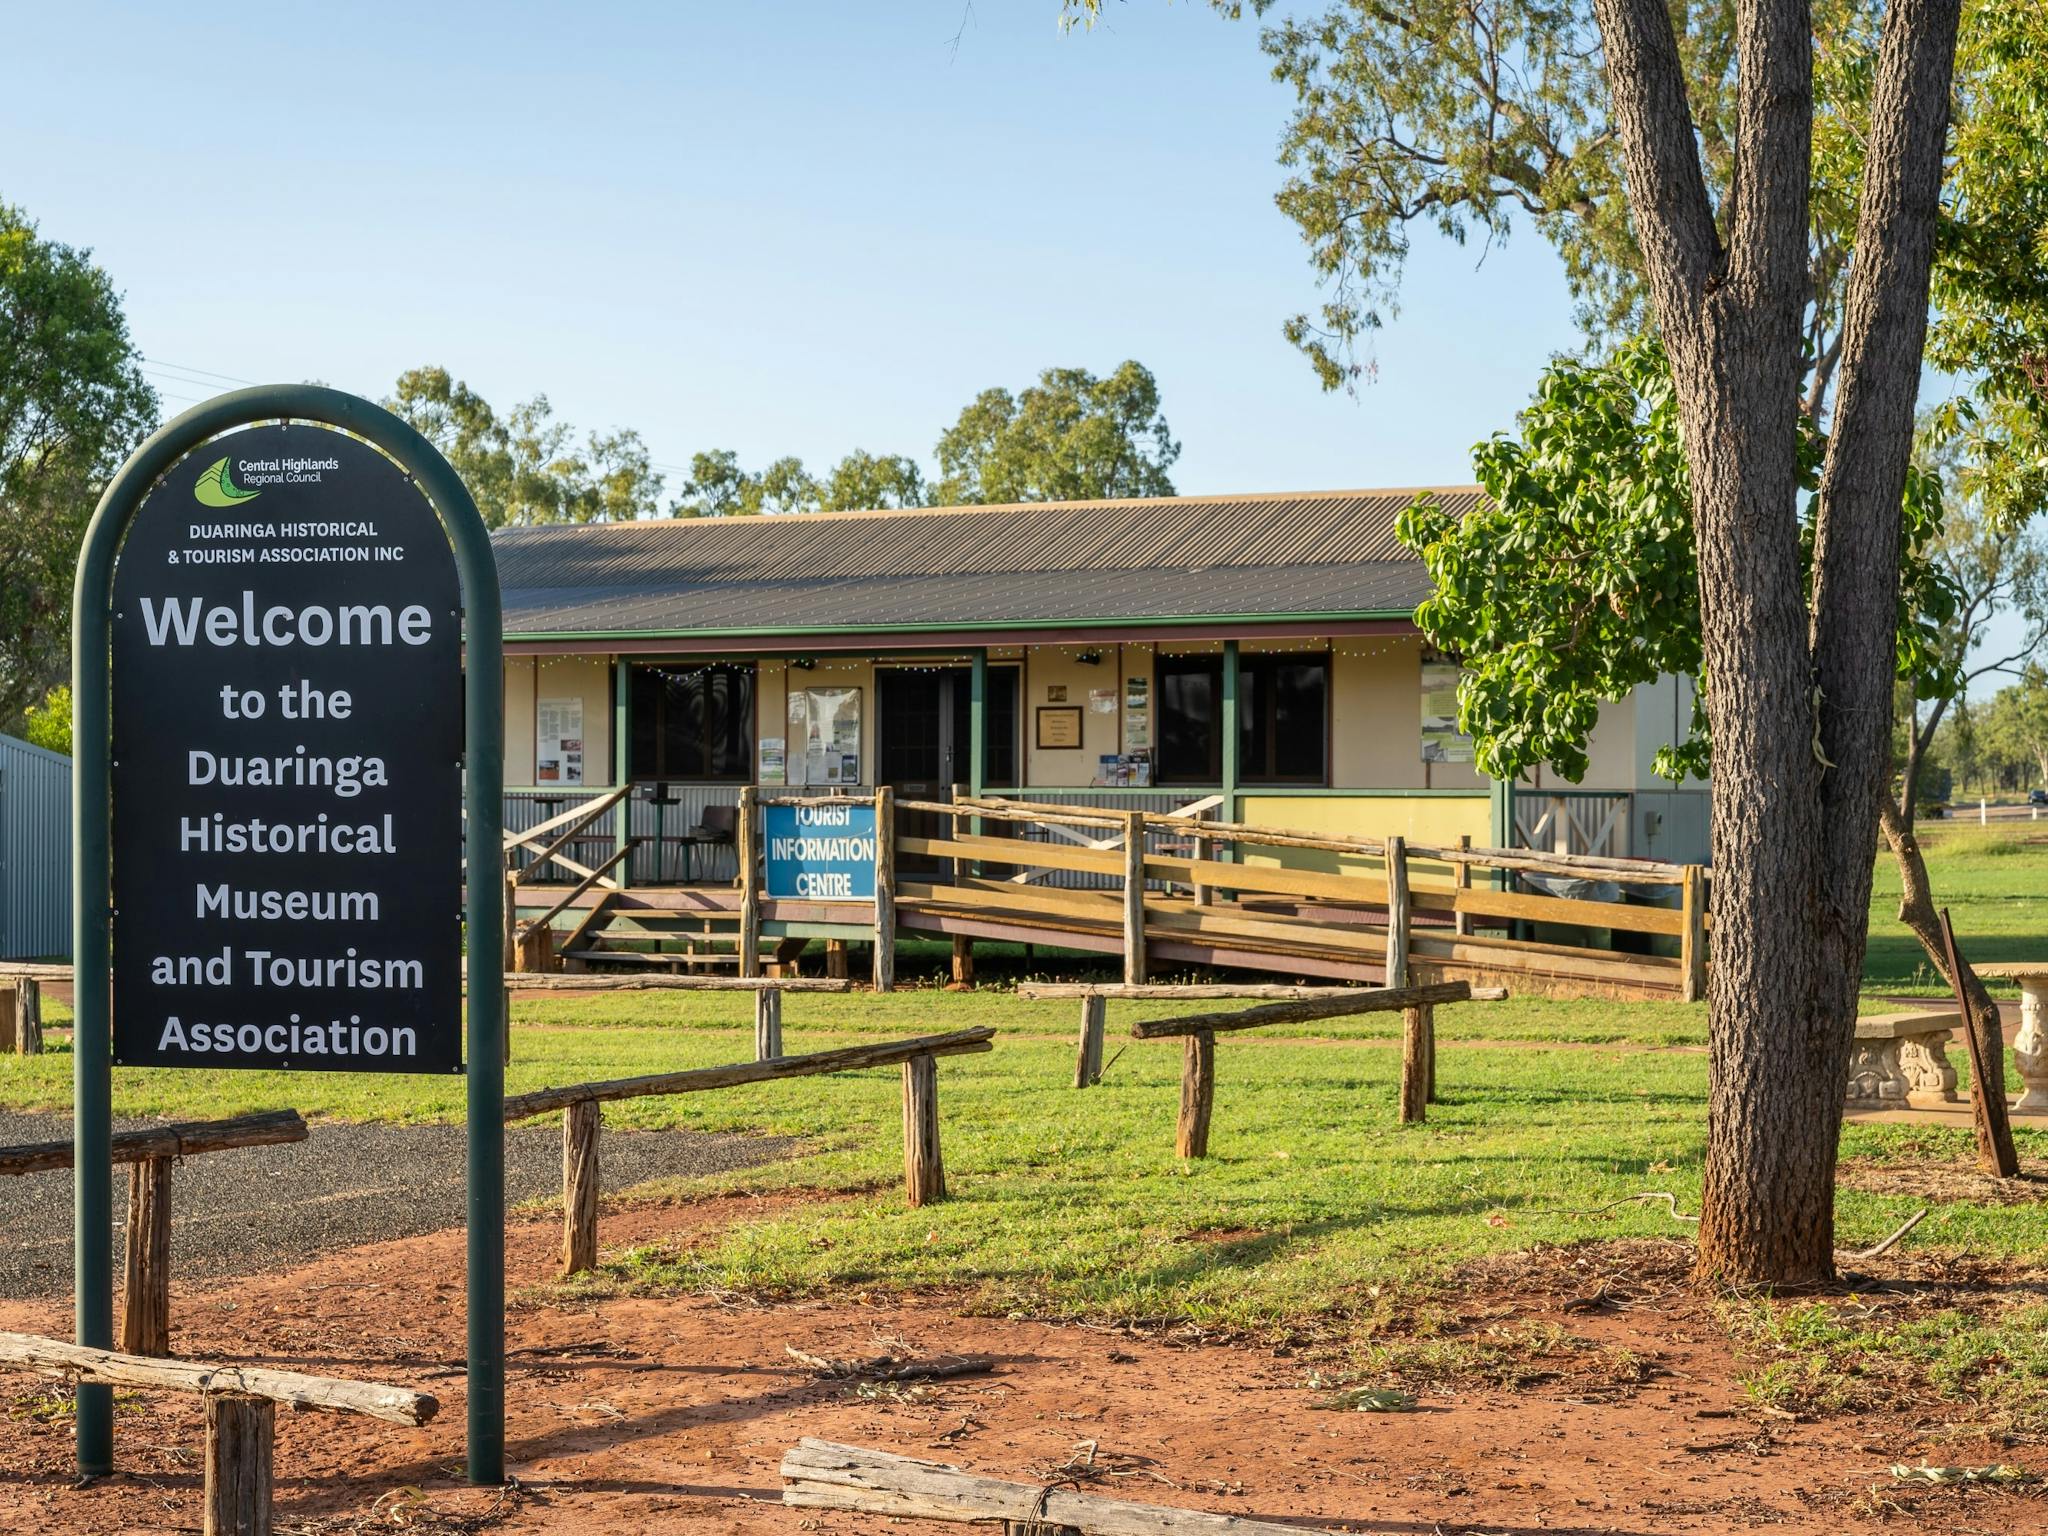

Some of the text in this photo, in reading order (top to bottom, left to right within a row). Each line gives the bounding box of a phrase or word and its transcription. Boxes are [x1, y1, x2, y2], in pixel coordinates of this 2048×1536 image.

[239, 458, 338, 472] Central Highlands
[244, 471, 321, 486] Regional Council
[190, 522, 377, 538] DUARINGA HISTORICAL
[168, 547, 403, 564] & TOURISM ASSOCIATION INC
[140, 591, 431, 647] Welcome
[220, 680, 351, 719] to the
[188, 745, 388, 797] Duaringa
[795, 805, 851, 826] TOURIST
[181, 813, 396, 853] Historical
[772, 838, 874, 861] INFORMATION
[796, 873, 852, 896] CENTRE
[196, 884, 379, 920] Museum
[152, 947, 422, 988] and Tourism
[158, 1014, 416, 1056] Association
